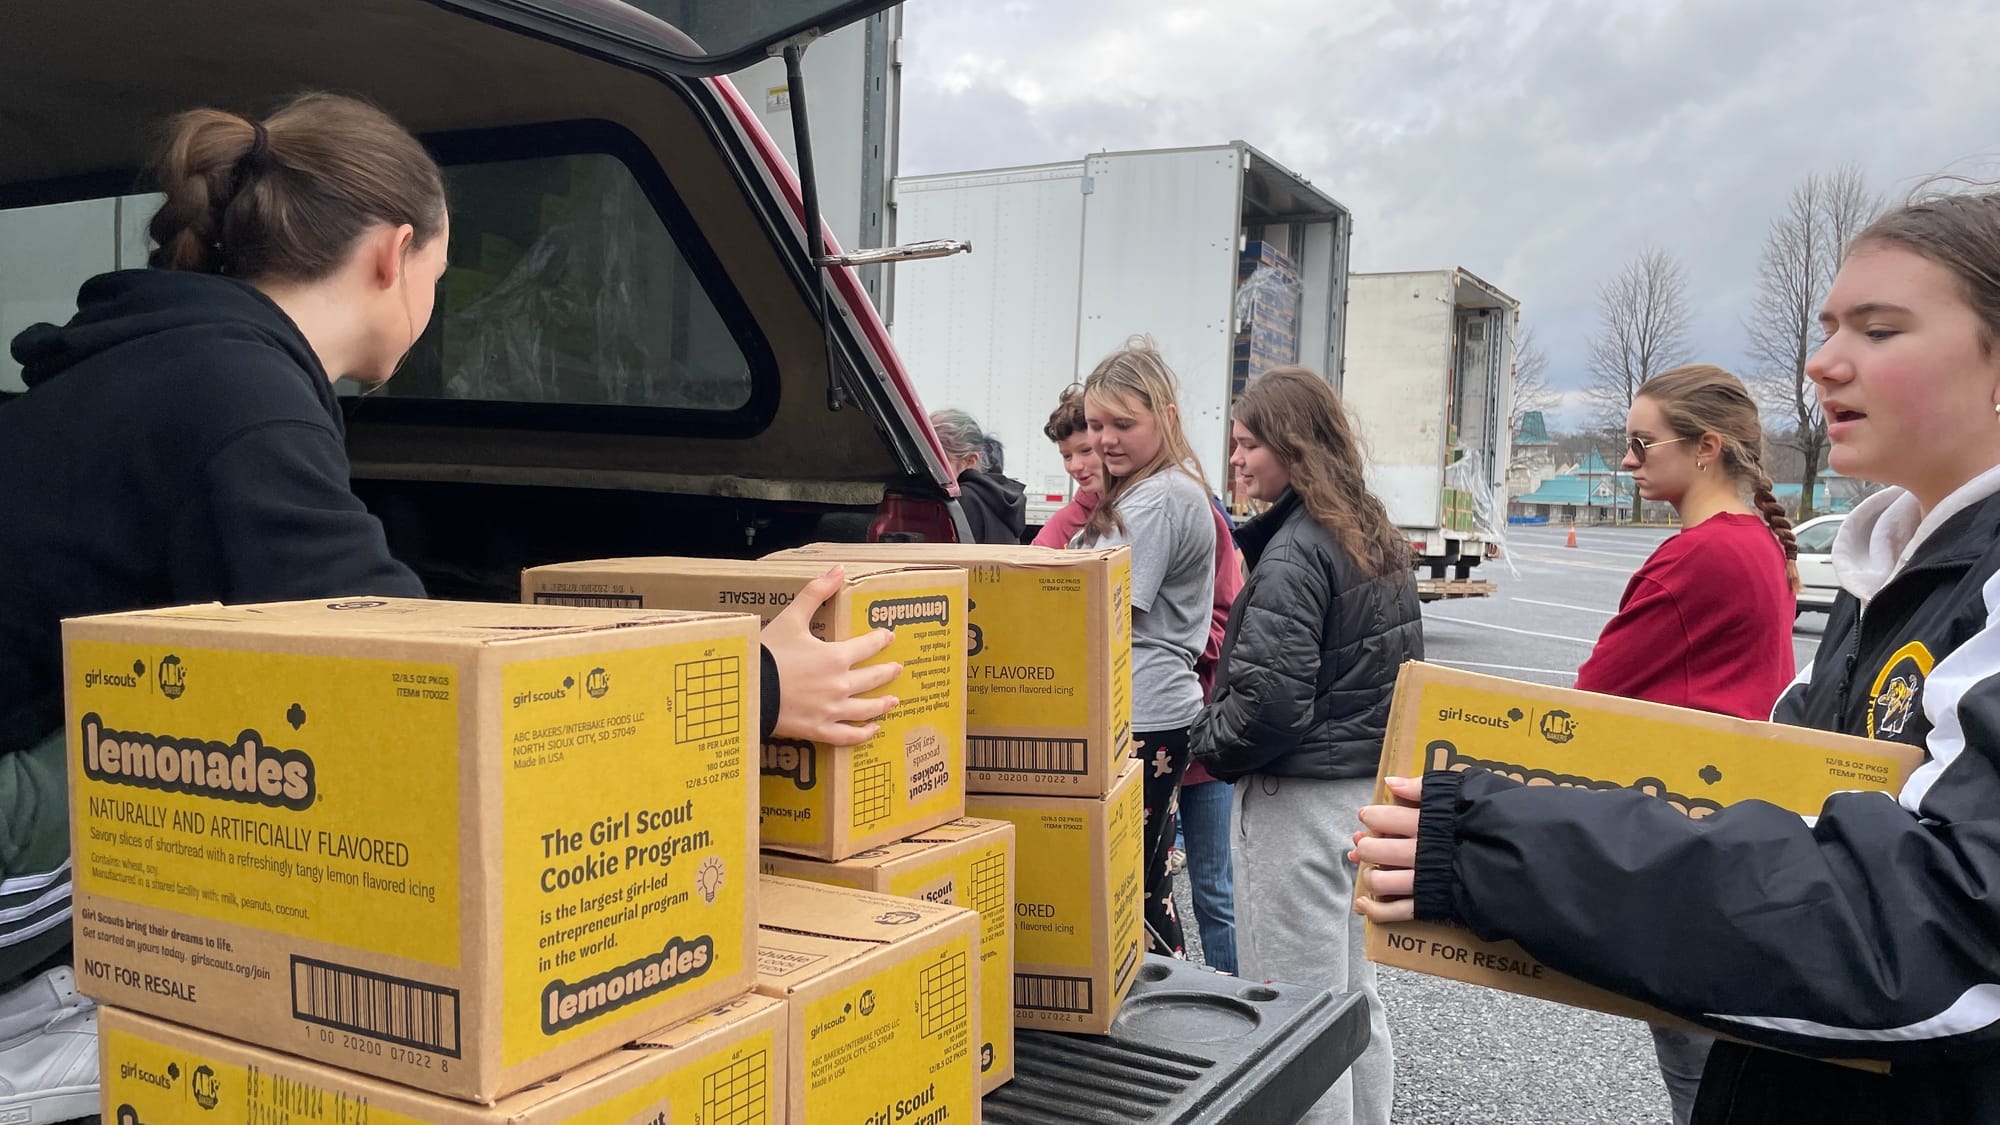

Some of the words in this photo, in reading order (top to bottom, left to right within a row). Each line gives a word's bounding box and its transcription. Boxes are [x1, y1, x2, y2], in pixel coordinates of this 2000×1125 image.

[719, 592, 765, 605] RESALE
[870, 599, 948, 628] lemonades
[85, 669, 102, 688] girl
[103, 674, 136, 688] scouts
[416, 674, 427, 684] OZ
[984, 666, 1055, 681] FLAVORED
[397, 687, 420, 698] ITEM#
[422, 690, 449, 700] 170022
[513, 690, 532, 708] girl
[532, 688, 566, 702] scouts
[966, 685, 989, 694] tangy
[991, 684, 1017, 694] lemon
[1019, 684, 1052, 694] flavored
[1054, 686, 1074, 696] icing
[513, 732, 530, 744] ABC
[532, 718, 606, 740] BAKERS/INTERBAKE
[606, 714, 631, 727] FOODS
[632, 712, 645, 722] LLC
[1438, 707, 1462, 722] girl
[1464, 713, 1510, 729] scouts
[1543, 714, 1572, 735] ABC
[512, 742, 545, 757] NORTH
[547, 736, 574, 750] SIOUX
[576, 734, 597, 746] CITY,
[598, 730, 610, 742] SD
[612, 726, 636, 739] 57049
[698, 743, 706, 752] 18
[706, 740, 720, 750] PER
[721, 736, 740, 748] LAYER
[906, 742, 922, 758] local
[86, 719, 311, 803] lemonades
[514, 756, 536, 770] Made
[538, 754, 546, 766] in
[548, 752, 564, 764] USA
[715, 750, 722, 759] 10
[724, 747, 740, 758] HIGH
[913, 745, 941, 768] proceeds
[706, 762, 718, 772] 180
[718, 758, 740, 768] CASES
[913, 761, 945, 784] Cookies
[1829, 768, 1856, 778] ITEM#
[1858, 773, 1888, 784] 170022
[1852, 762, 1864, 770] OZ
[1866, 764, 1888, 774] PKGS
[685, 775, 708, 790] 12/8.5
[708, 773, 720, 784] OZ
[720, 769, 740, 782] PKGS
[934, 772, 949, 788] Girl
[979, 773, 991, 782] 00
[998, 774, 1028, 782] 20200
[1034, 774, 1066, 784] 07022
[1072, 776, 1078, 784] 8
[909, 781, 932, 800] Scout
[761, 806, 792, 816] scouts
[794, 808, 811, 822] girl
[90, 796, 167, 829] NATURALLY
[173, 810, 205, 835] AND
[210, 816, 312, 852] ARTIFICIALLY
[318, 832, 410, 868] FLAVORED
[540, 828, 583, 859] The
[590, 812, 630, 846] Girl
[636, 799, 694, 834] Scout
[90, 826, 117, 846] Savory
[120, 830, 142, 848] slices
[144, 836, 154, 850] of
[156, 838, 204, 859] shortbread
[206, 847, 226, 863] with
[228, 854, 234, 865] a
[237, 852, 293, 878] refreshingly
[296, 862, 324, 884] tangy
[326, 865, 359, 886] lemon
[363, 872, 406, 894] flavored
[409, 880, 436, 903] icing
[540, 851, 619, 894] Cookie
[540, 910, 552, 926] is
[556, 902, 576, 922] the
[580, 888, 624, 914] largest
[626, 872, 668, 904] girl-led
[926, 880, 952, 903] Scout
[241, 898, 274, 914] peanuts,
[276, 903, 310, 920] coconut.
[538, 904, 638, 949] entrepreneurial
[640, 890, 689, 920] program
[82, 908, 96, 921] Girl
[98, 912, 124, 928] Scouts
[126, 918, 148, 936] bring
[148, 922, 169, 937] their
[170, 928, 204, 946] dreams
[206, 936, 214, 948] to
[216, 938, 234, 952] life.
[1020, 922, 1053, 932] flavored
[1055, 924, 1074, 935] icing
[82, 926, 96, 939] Get
[98, 930, 124, 946] started
[126, 938, 136, 948] on
[138, 940, 160, 954] yours
[161, 946, 188, 964] today.
[192, 953, 271, 980] girlscouts.org/join
[538, 956, 552, 973] in
[555, 949, 576, 967] the
[579, 933, 618, 958] world.
[1387, 933, 1426, 954] NOT
[1430, 943, 1468, 964] FOR
[1473, 951, 1544, 980] RESALE
[84, 958, 111, 981] NOT
[114, 966, 141, 989] FOR
[144, 974, 196, 1002] RESALE
[547, 941, 710, 1026] lemonades
[810, 1023, 824, 1040] girl
[824, 1014, 846, 1032] scouts
[952, 1020, 968, 1032] LAYER
[305, 1026, 310, 1038] 1
[320, 1028, 335, 1044] 00
[344, 1034, 382, 1056] 20200
[390, 1046, 431, 1069] 07022
[442, 1060, 448, 1072] 8
[952, 1038, 968, 1050] CASES
[811, 1063, 833, 1080] NORTH
[868, 1042, 876, 1052] SD
[946, 1056, 953, 1066] OZ
[953, 1048, 968, 1062] PKGS
[120, 1062, 138, 1079] girl
[138, 1071, 171, 1090] scouts
[812, 1076, 827, 1090] Made
[834, 1066, 846, 1080] USA
[895, 1082, 935, 1121] Scout
